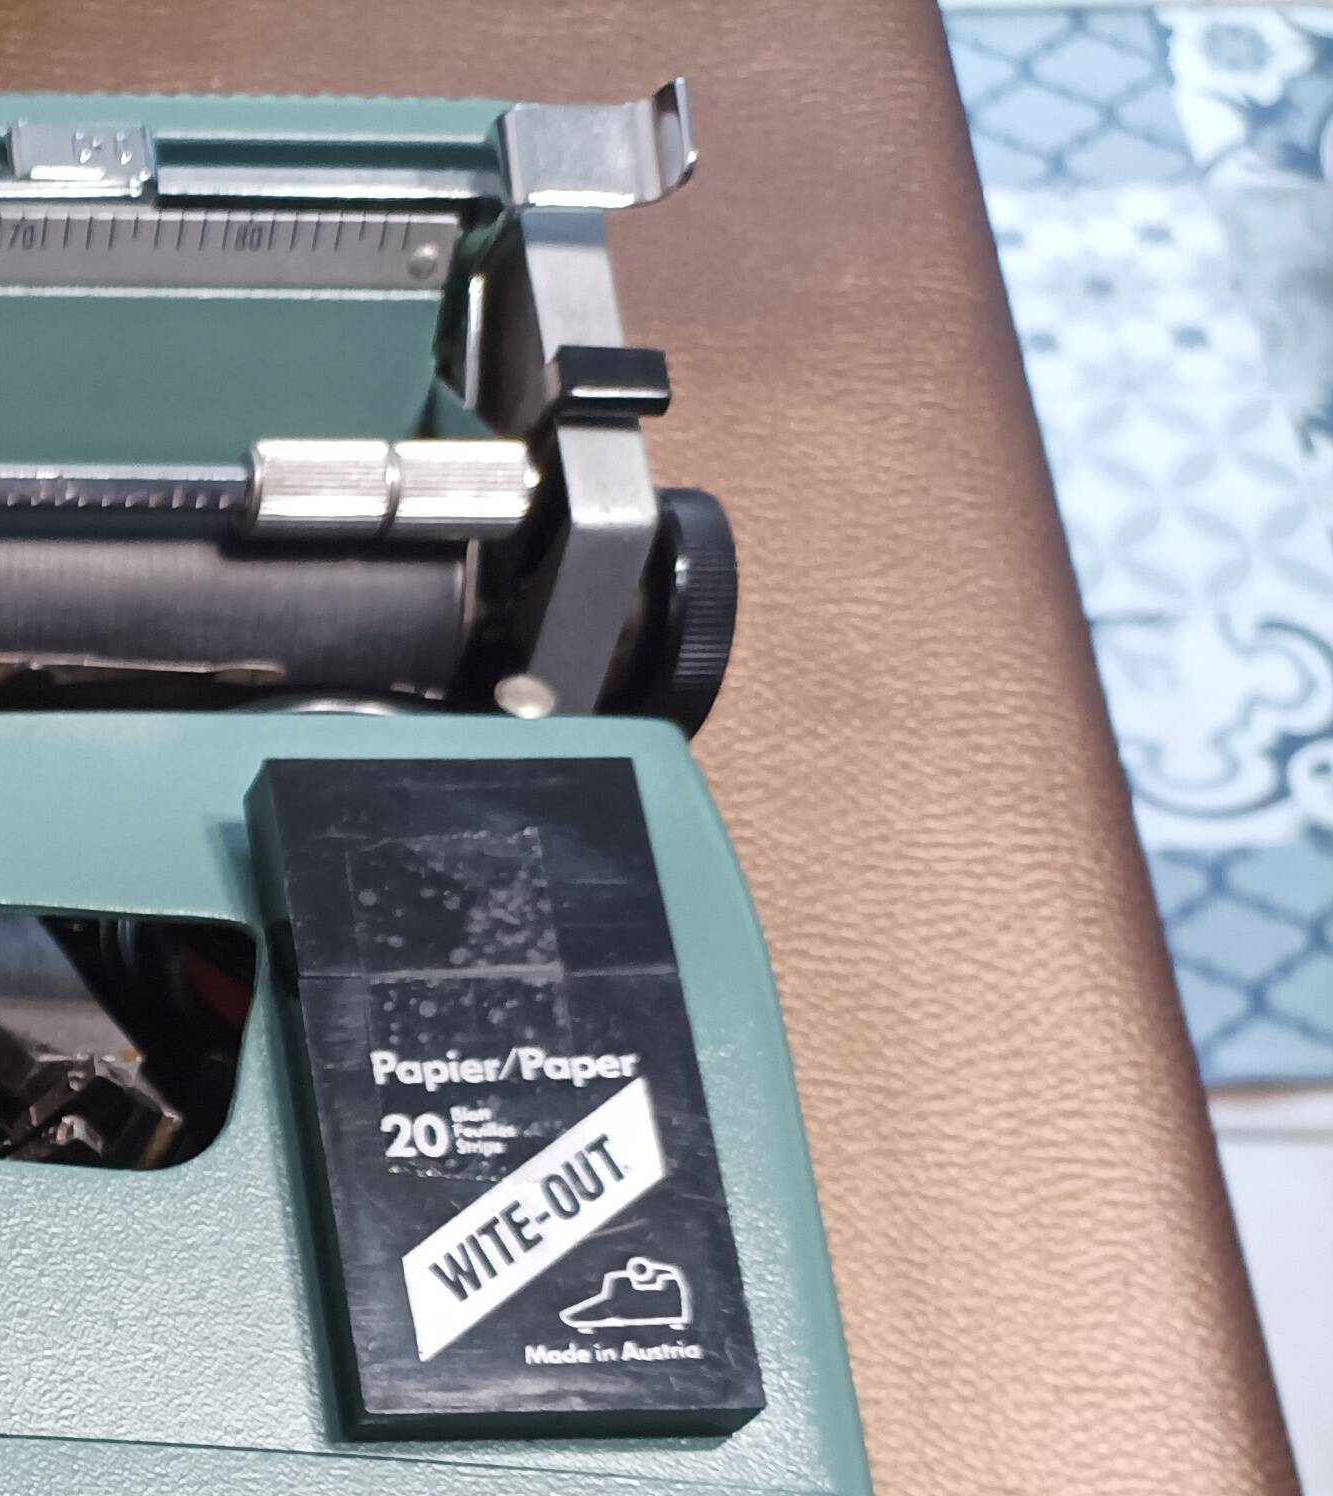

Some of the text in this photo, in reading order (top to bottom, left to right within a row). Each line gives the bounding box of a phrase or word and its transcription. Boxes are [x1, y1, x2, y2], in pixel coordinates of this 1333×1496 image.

[8, 222, 34, 251] 70
[233, 224, 263, 253] 80
[370, 1046, 638, 1092] Papier/Paper
[380, 1112, 449, 1158] 20
[428, 1134, 627, 1302] WITE-OUT
[525, 1340, 702, 1364] Made in Austria
